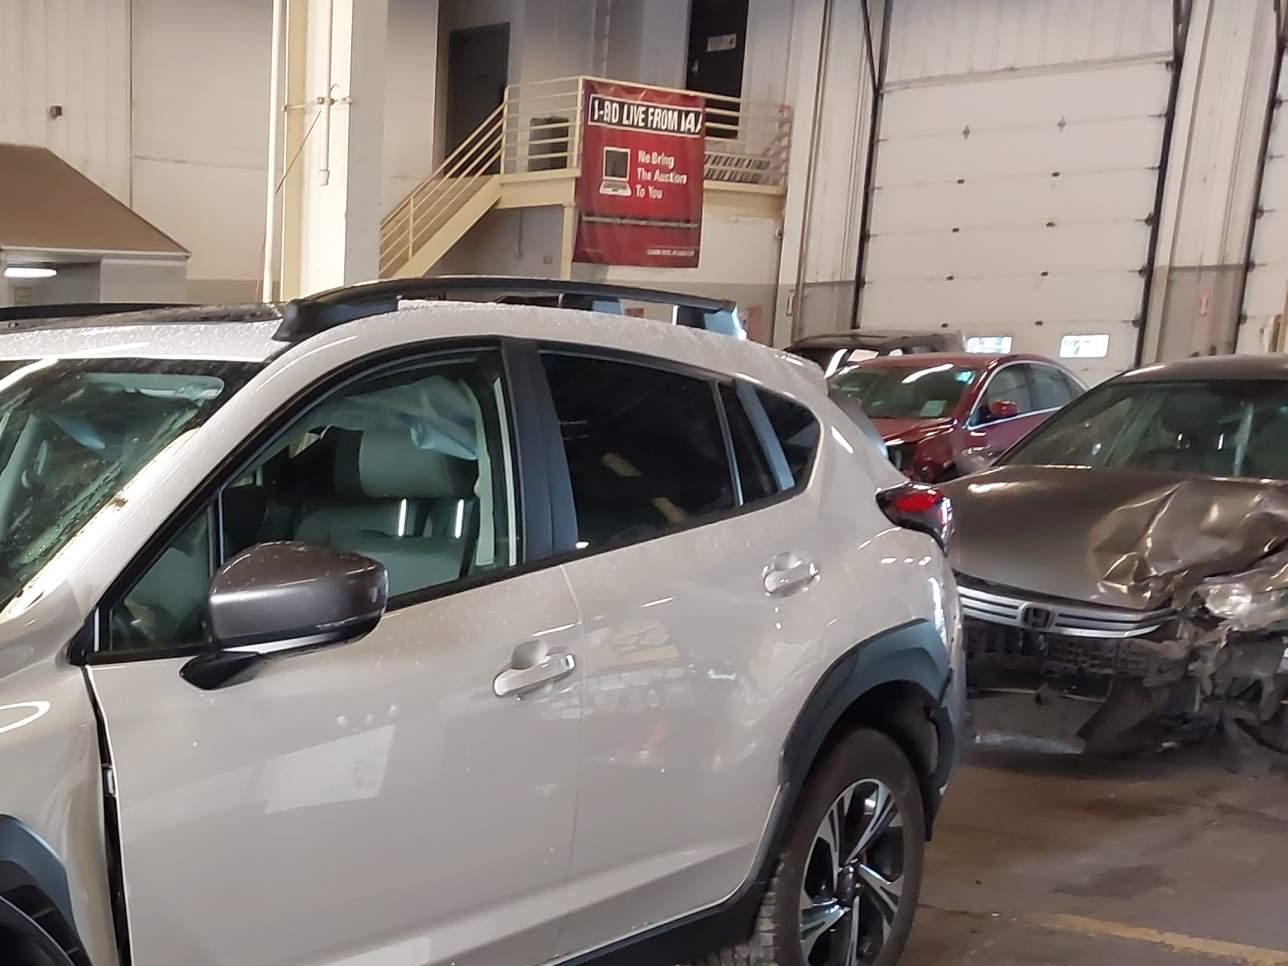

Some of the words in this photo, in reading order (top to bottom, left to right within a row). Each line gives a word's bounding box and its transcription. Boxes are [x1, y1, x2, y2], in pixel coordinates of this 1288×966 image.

[622, 103, 647, 128] LIVE
[647, 107, 679, 132] FROM
[652, 151, 675, 169] Bring
[637, 167, 652, 181] The
[653, 168, 688, 184] Auction
[635, 184, 646, 198] To
[648, 185, 663, 199] You
